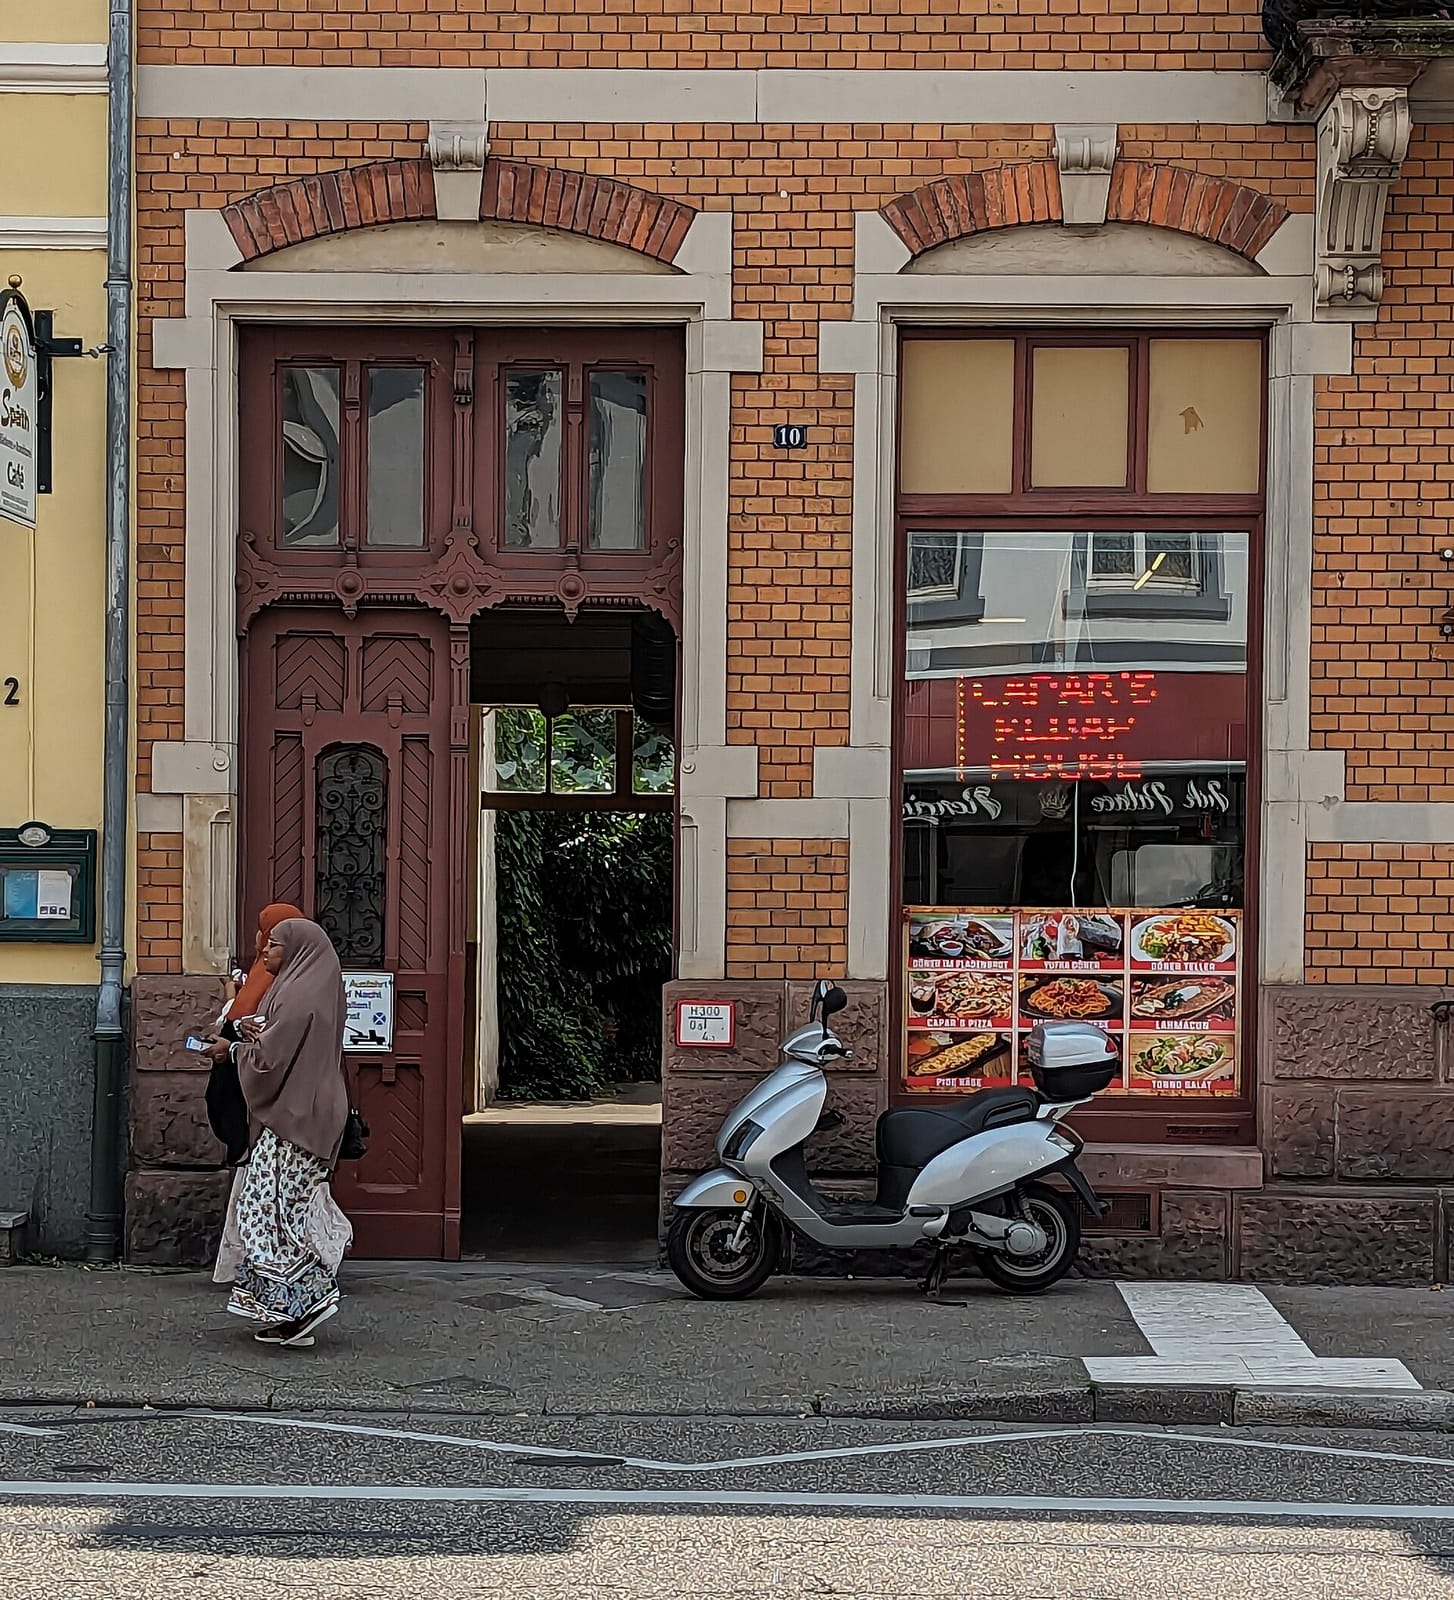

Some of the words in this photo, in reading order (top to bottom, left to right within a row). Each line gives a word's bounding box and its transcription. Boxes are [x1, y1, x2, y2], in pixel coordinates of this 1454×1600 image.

[779, 427, 801, 446] 10
[4, 677, 20, 705] 2
[1183, 962, 1216, 971] TELLER
[968, 1018, 993, 1028] PIZZA
[1155, 1020, 1210, 1030] LAHMACUN
